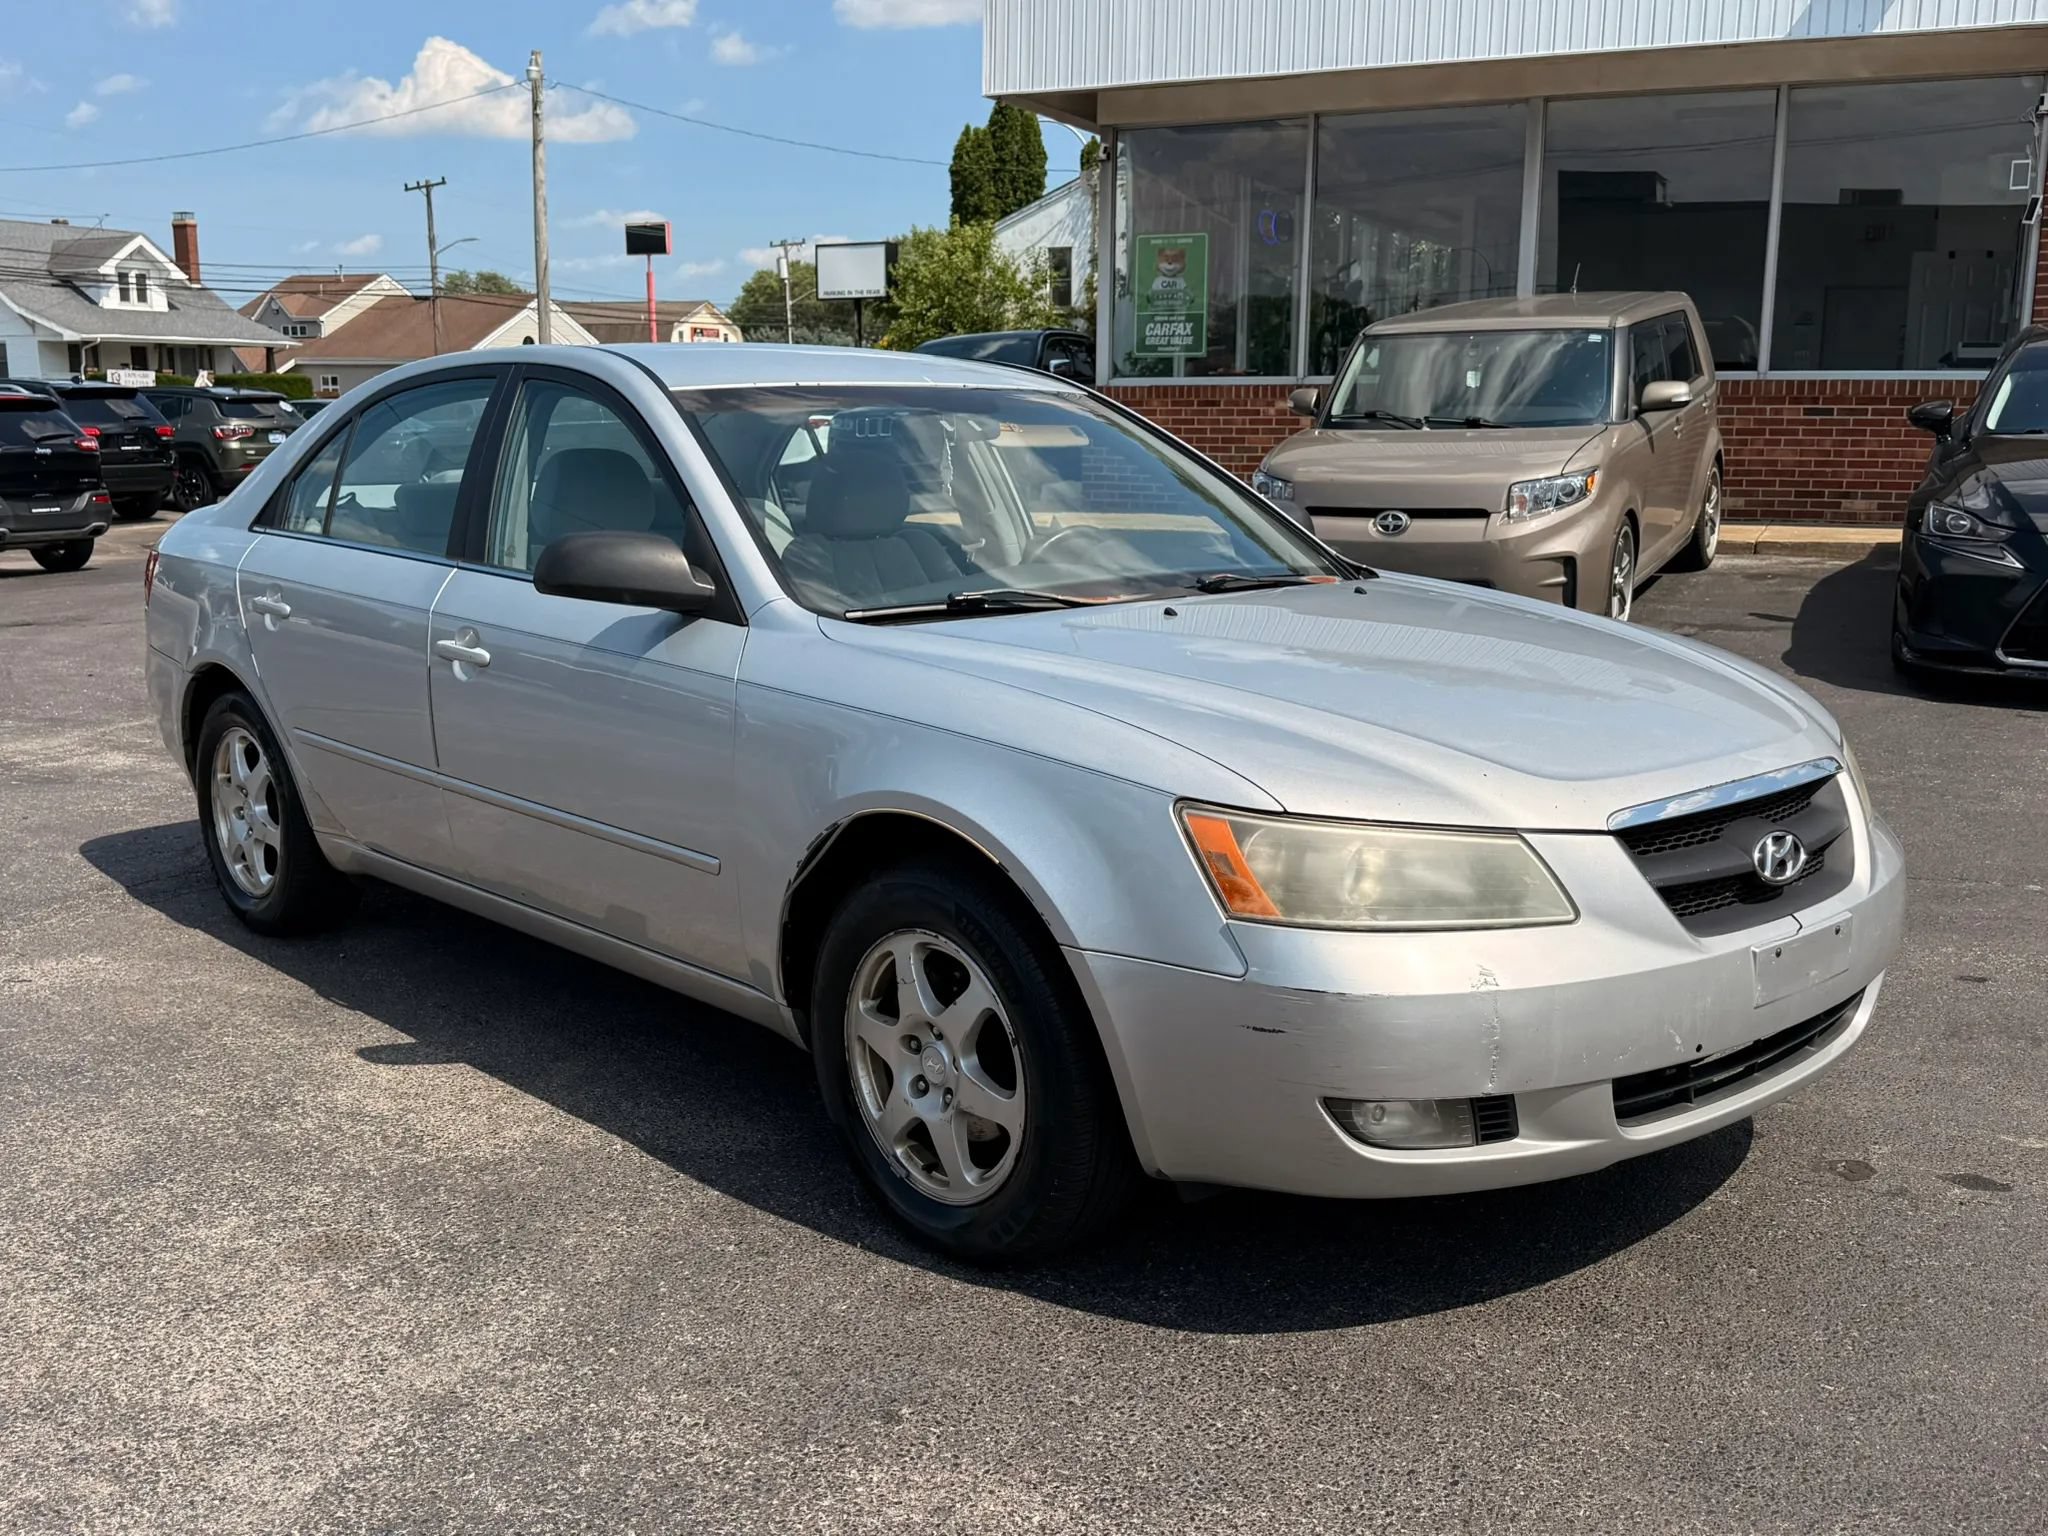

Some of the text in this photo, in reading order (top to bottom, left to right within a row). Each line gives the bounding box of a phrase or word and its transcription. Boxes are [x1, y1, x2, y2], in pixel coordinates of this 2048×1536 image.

[1145, 322, 1193, 336] CARFAX
[1145, 336, 1193, 345] GREAT VALUE
